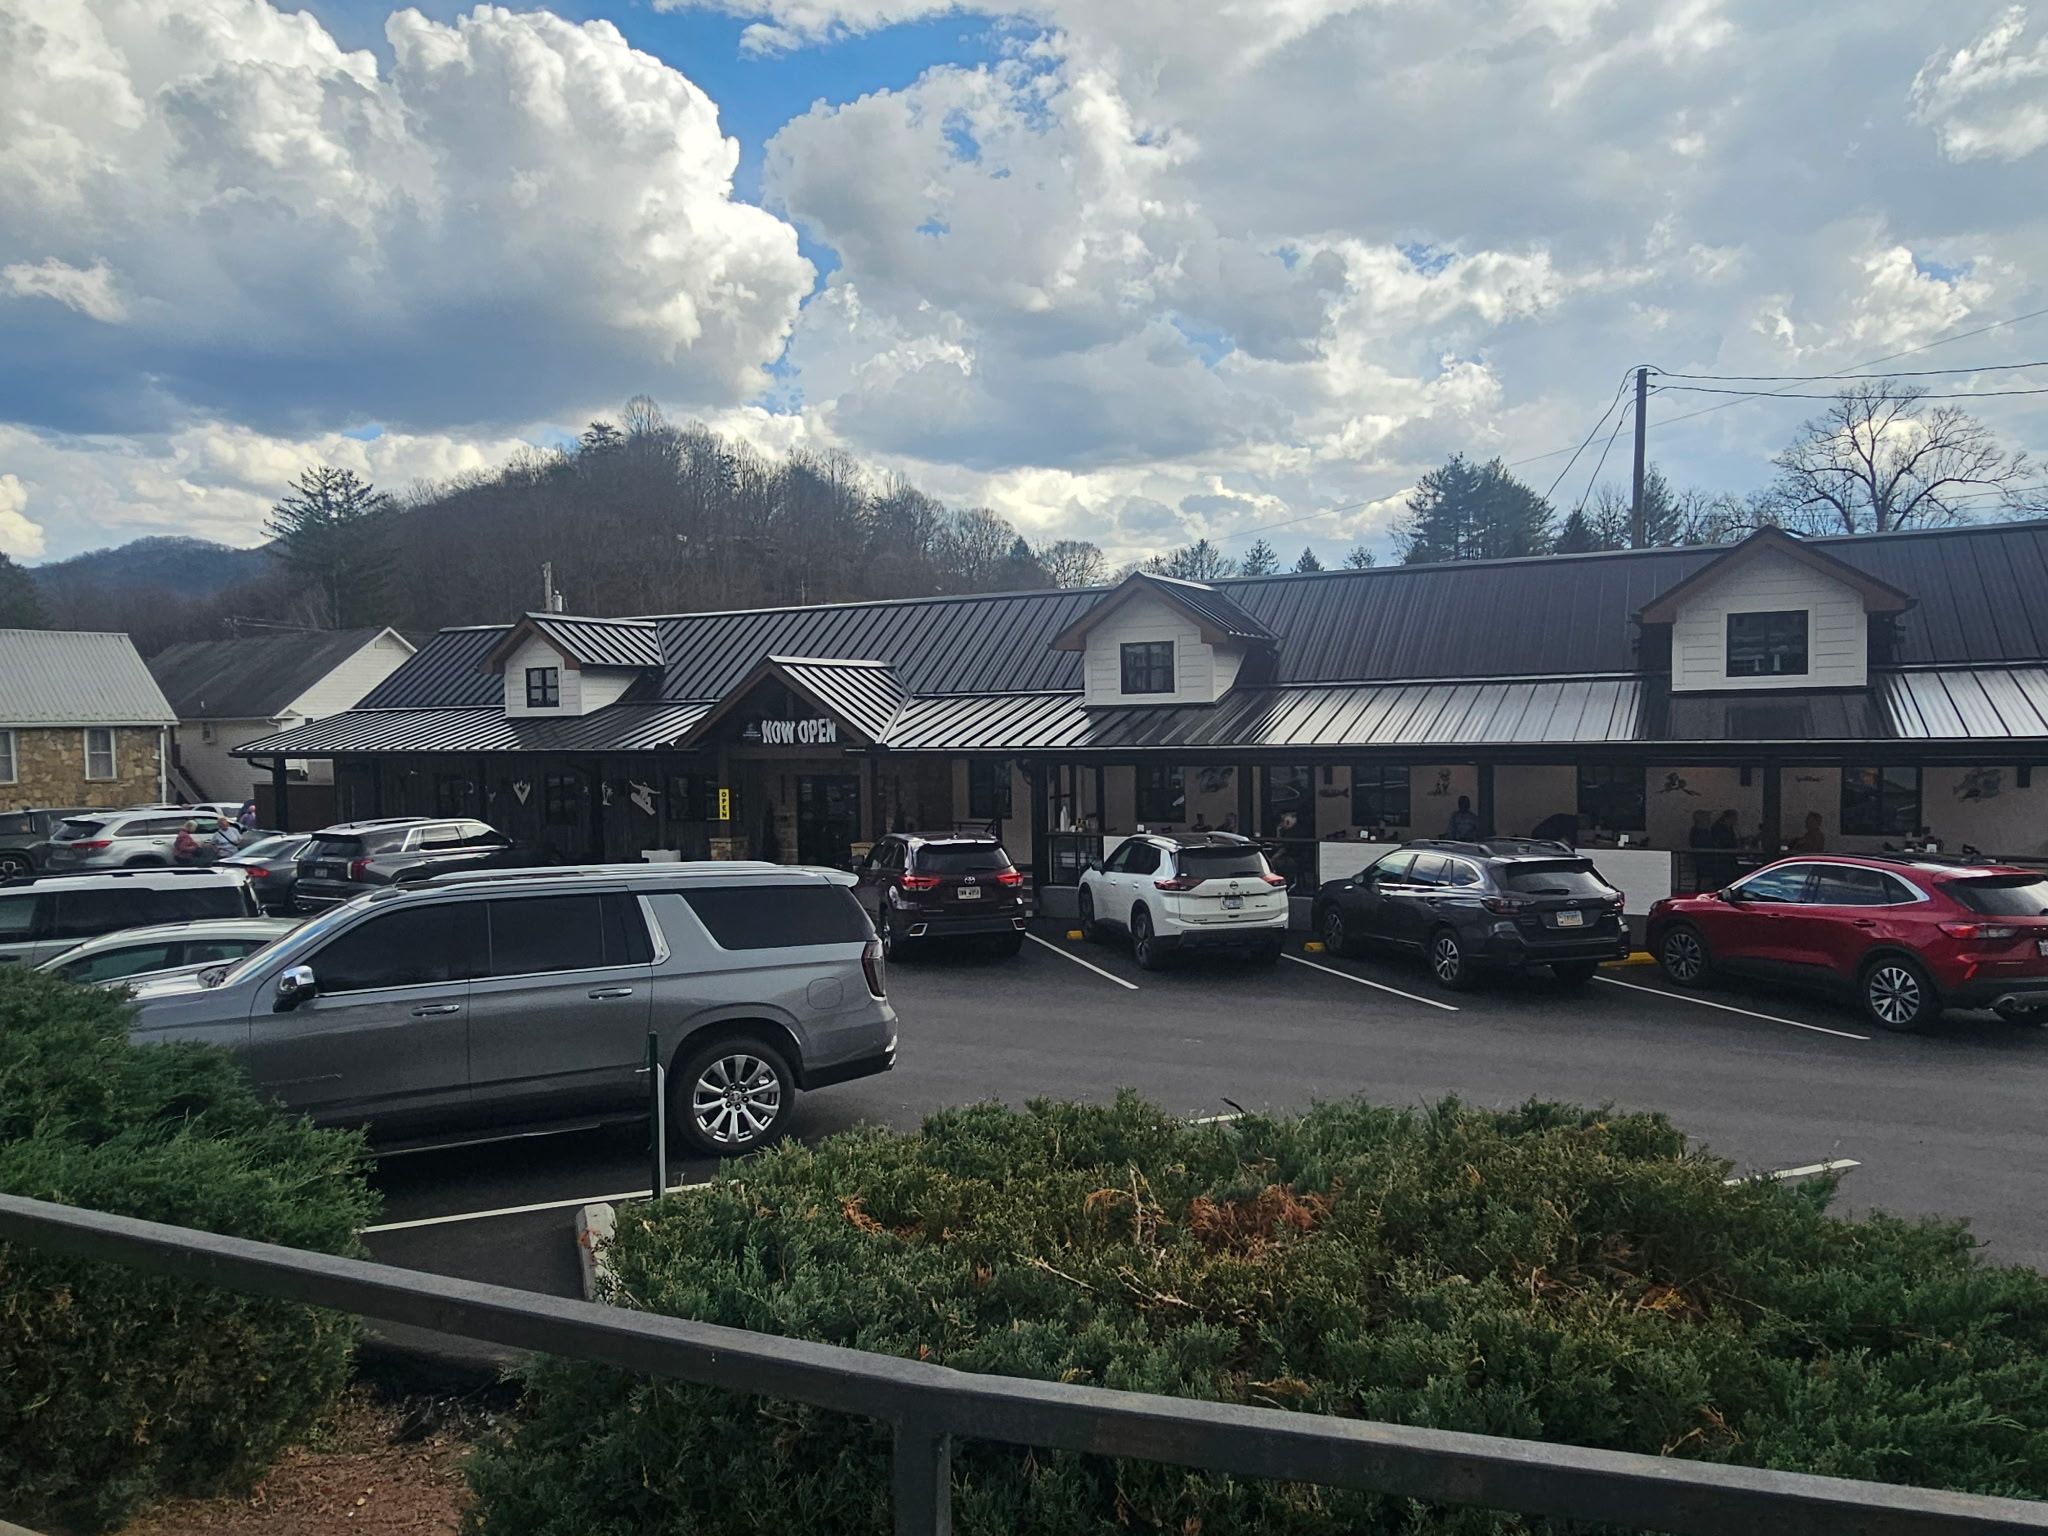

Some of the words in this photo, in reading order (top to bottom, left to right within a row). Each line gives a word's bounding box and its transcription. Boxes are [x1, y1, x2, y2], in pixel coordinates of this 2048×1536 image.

[761, 719, 796, 744] NOW
[797, 718, 837, 744] OPEN
[720, 791, 728, 818] OPEN
